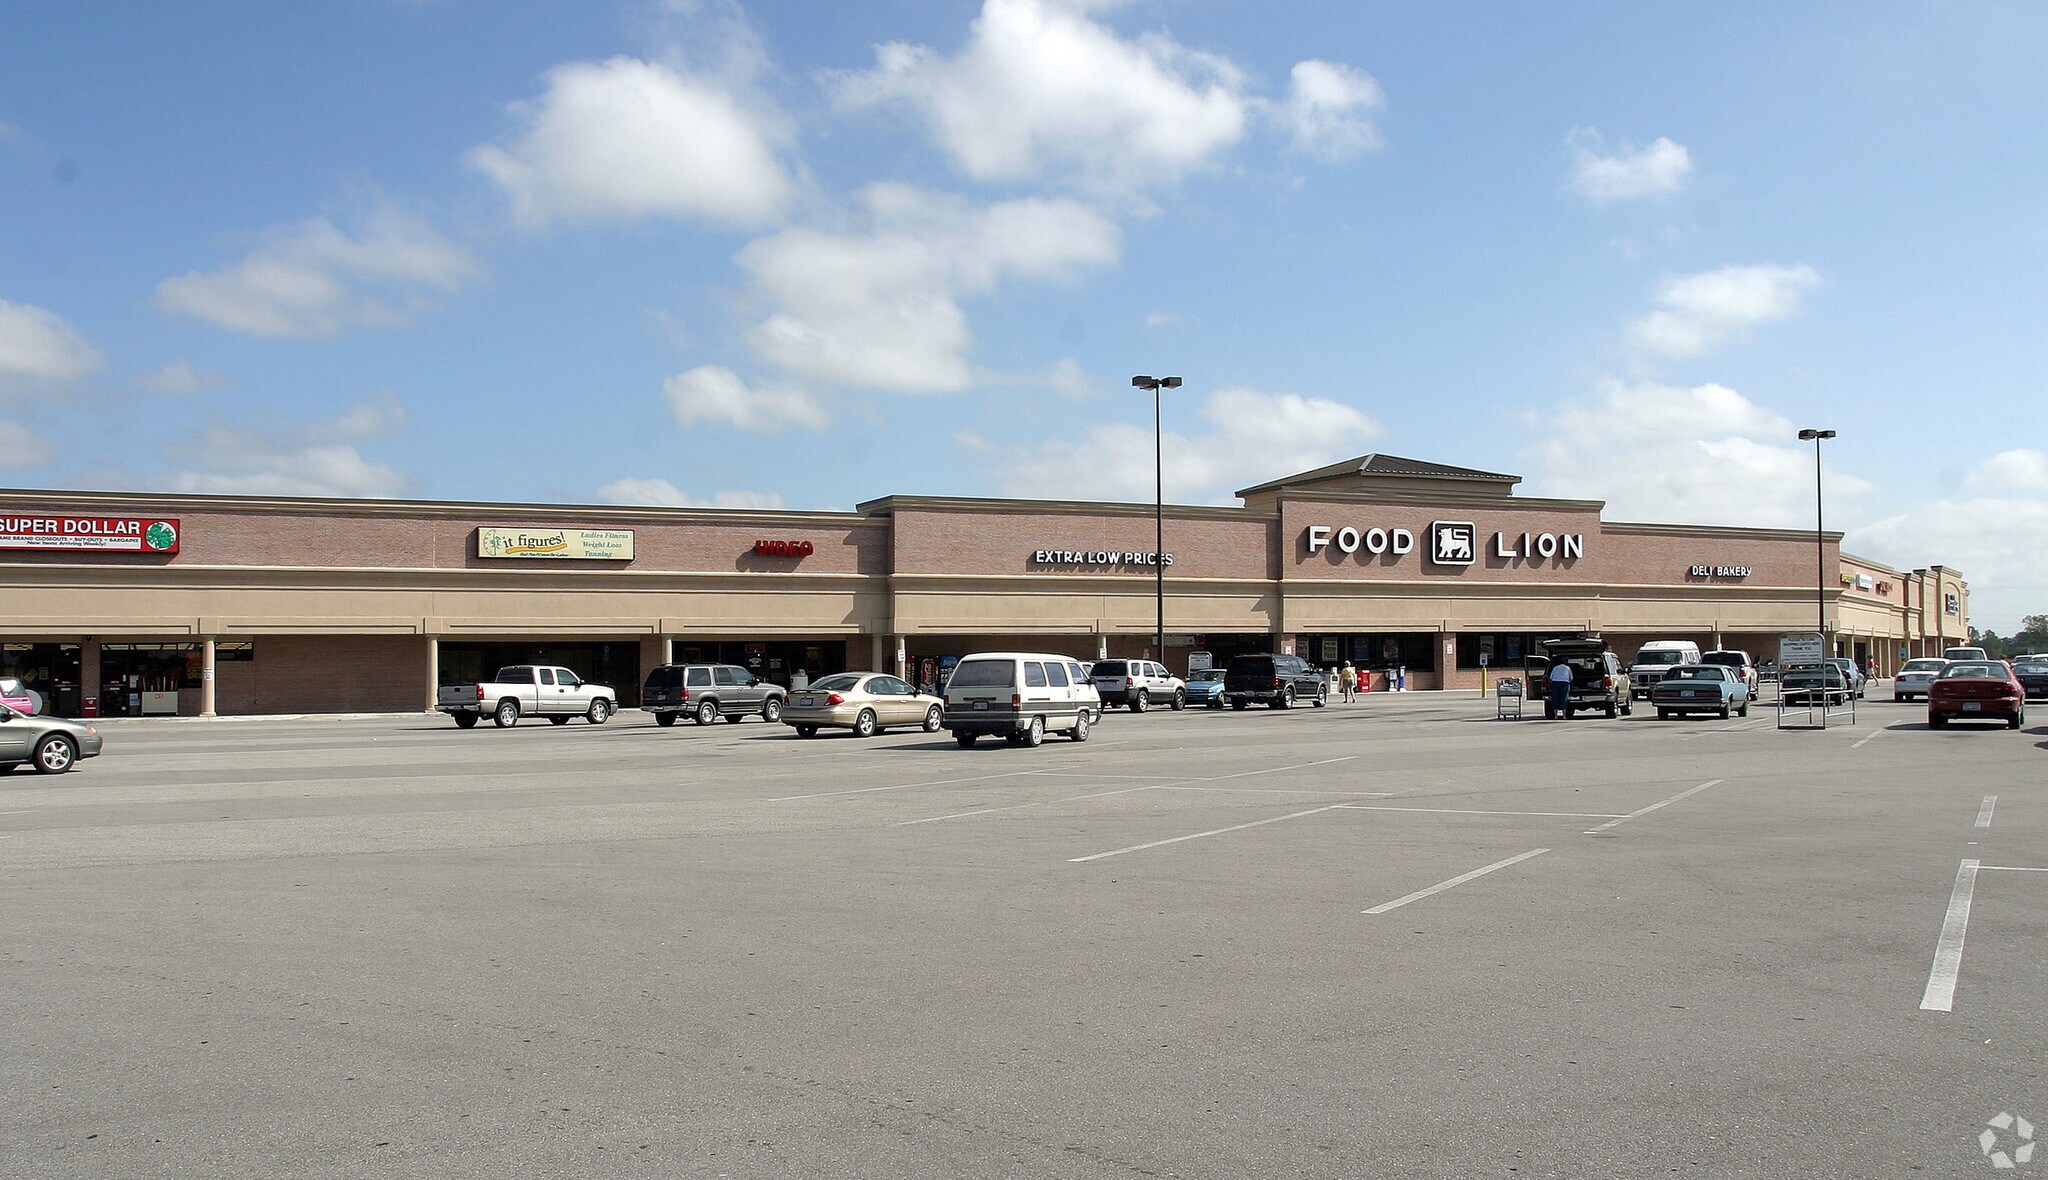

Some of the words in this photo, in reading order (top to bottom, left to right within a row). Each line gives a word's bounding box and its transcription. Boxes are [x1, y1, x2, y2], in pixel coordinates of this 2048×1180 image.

[63, 519, 140, 534] DOLLAR
[502, 536, 513, 548] it
[518, 531, 566, 549] figures!
[582, 541, 605, 549] Weight
[1309, 525, 1414, 554] FOOD
[1498, 531, 1583, 558] LION
[755, 540, 814, 557] VIDEO
[1036, 550, 1083, 563] EXTRA
[1088, 551, 1120, 564] LOW
[1692, 565, 1712, 576] DELI
[1717, 566, 1752, 577] BAKERY
